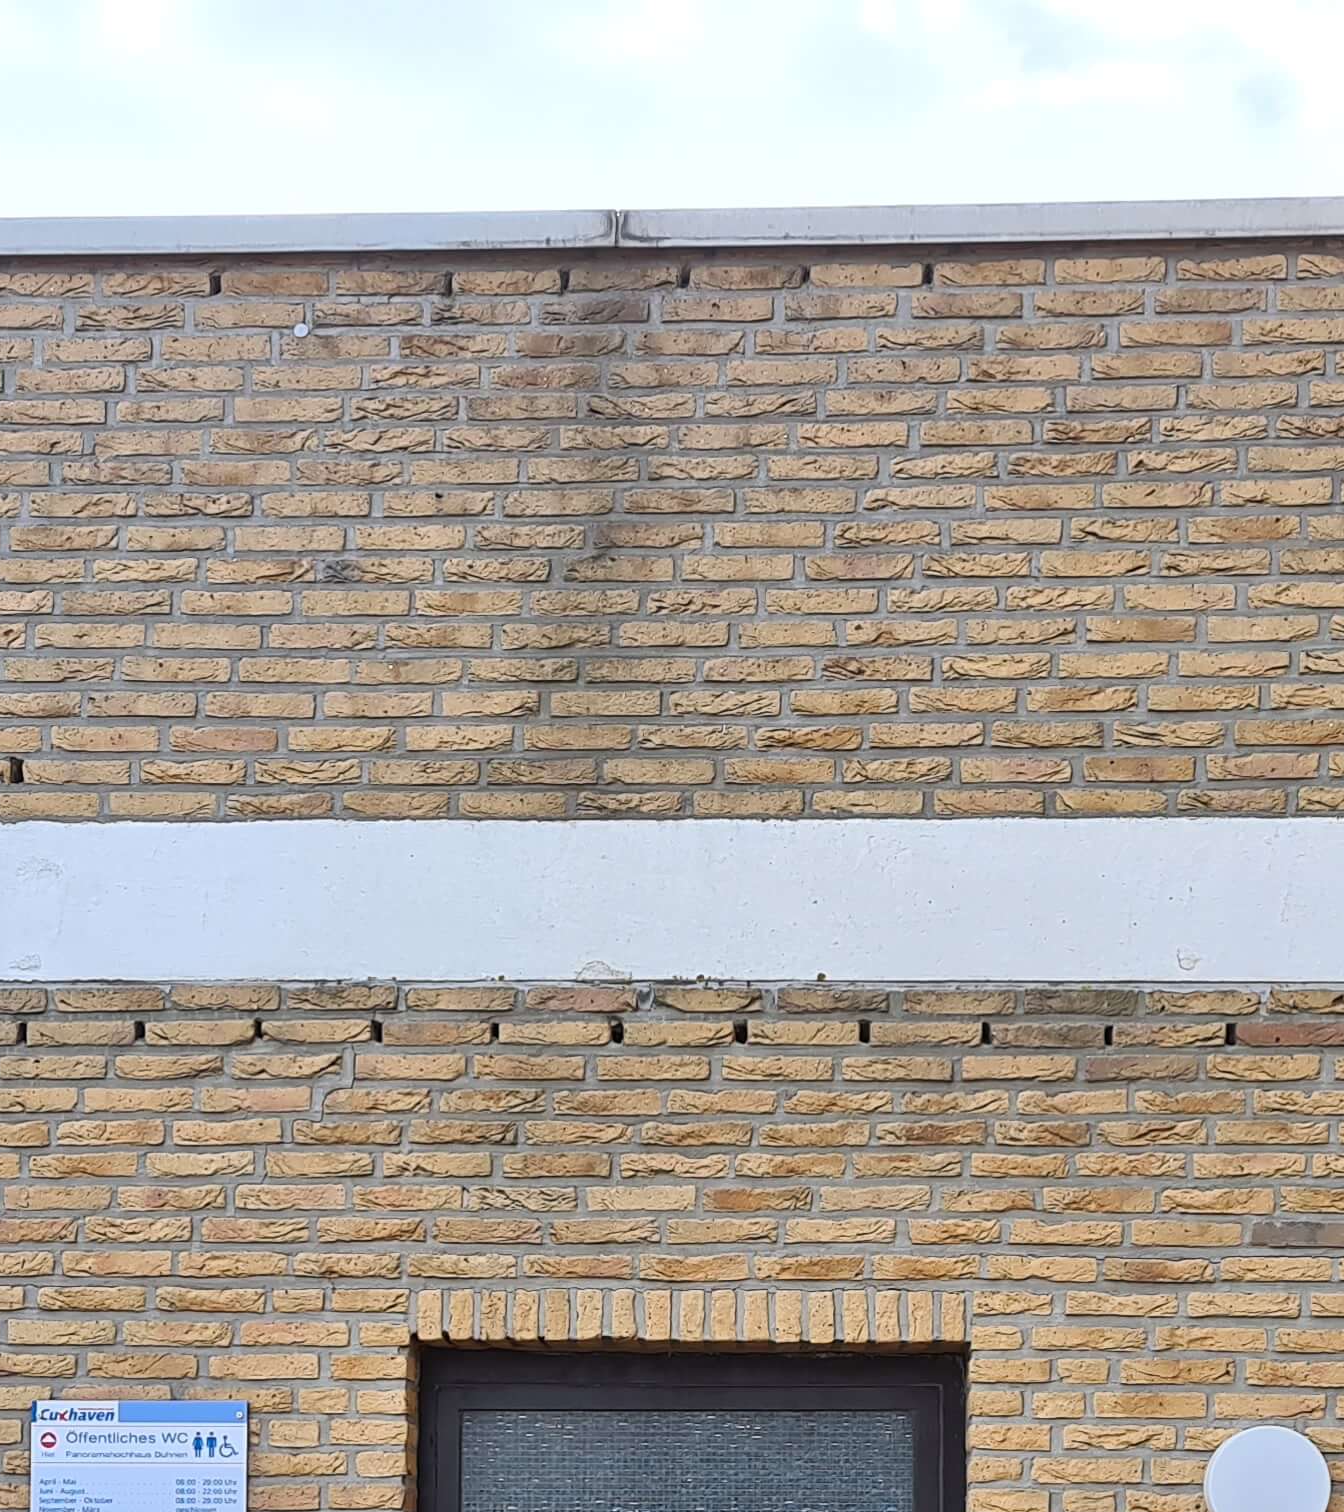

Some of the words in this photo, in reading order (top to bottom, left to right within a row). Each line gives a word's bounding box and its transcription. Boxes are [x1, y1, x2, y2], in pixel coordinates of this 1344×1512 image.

[40, 1408, 115, 1421] Cuxhaven
[66, 1430, 156, 1444] Öffentliches
[161, 1432, 189, 1444] WC
